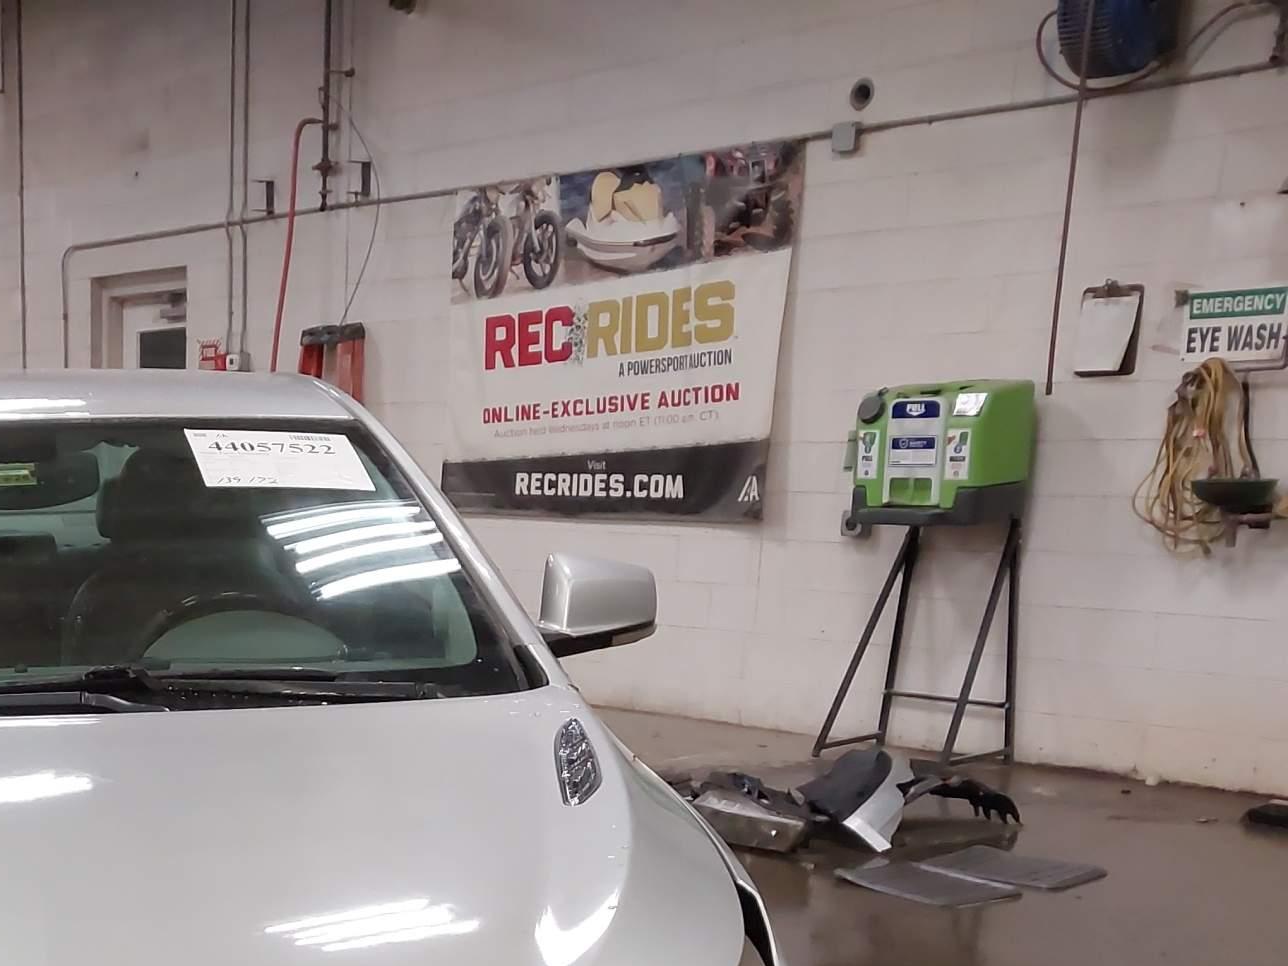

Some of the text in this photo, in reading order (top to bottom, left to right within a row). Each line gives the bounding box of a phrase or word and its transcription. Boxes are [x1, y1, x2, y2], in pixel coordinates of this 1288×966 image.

[1193, 293, 1285, 314] EMERGENCY
[484, 279, 736, 371] REC RIDES
[1186, 322, 1282, 354] EYE WASH
[618, 362, 626, 378] A
[483, 382, 740, 424] ONLINE-EXCLUSIVE AUCTION
[208, 441, 336, 455] 44057522
[587, 459, 606, 471] Visit
[515, 472, 684, 499] RECRIDES.COM
